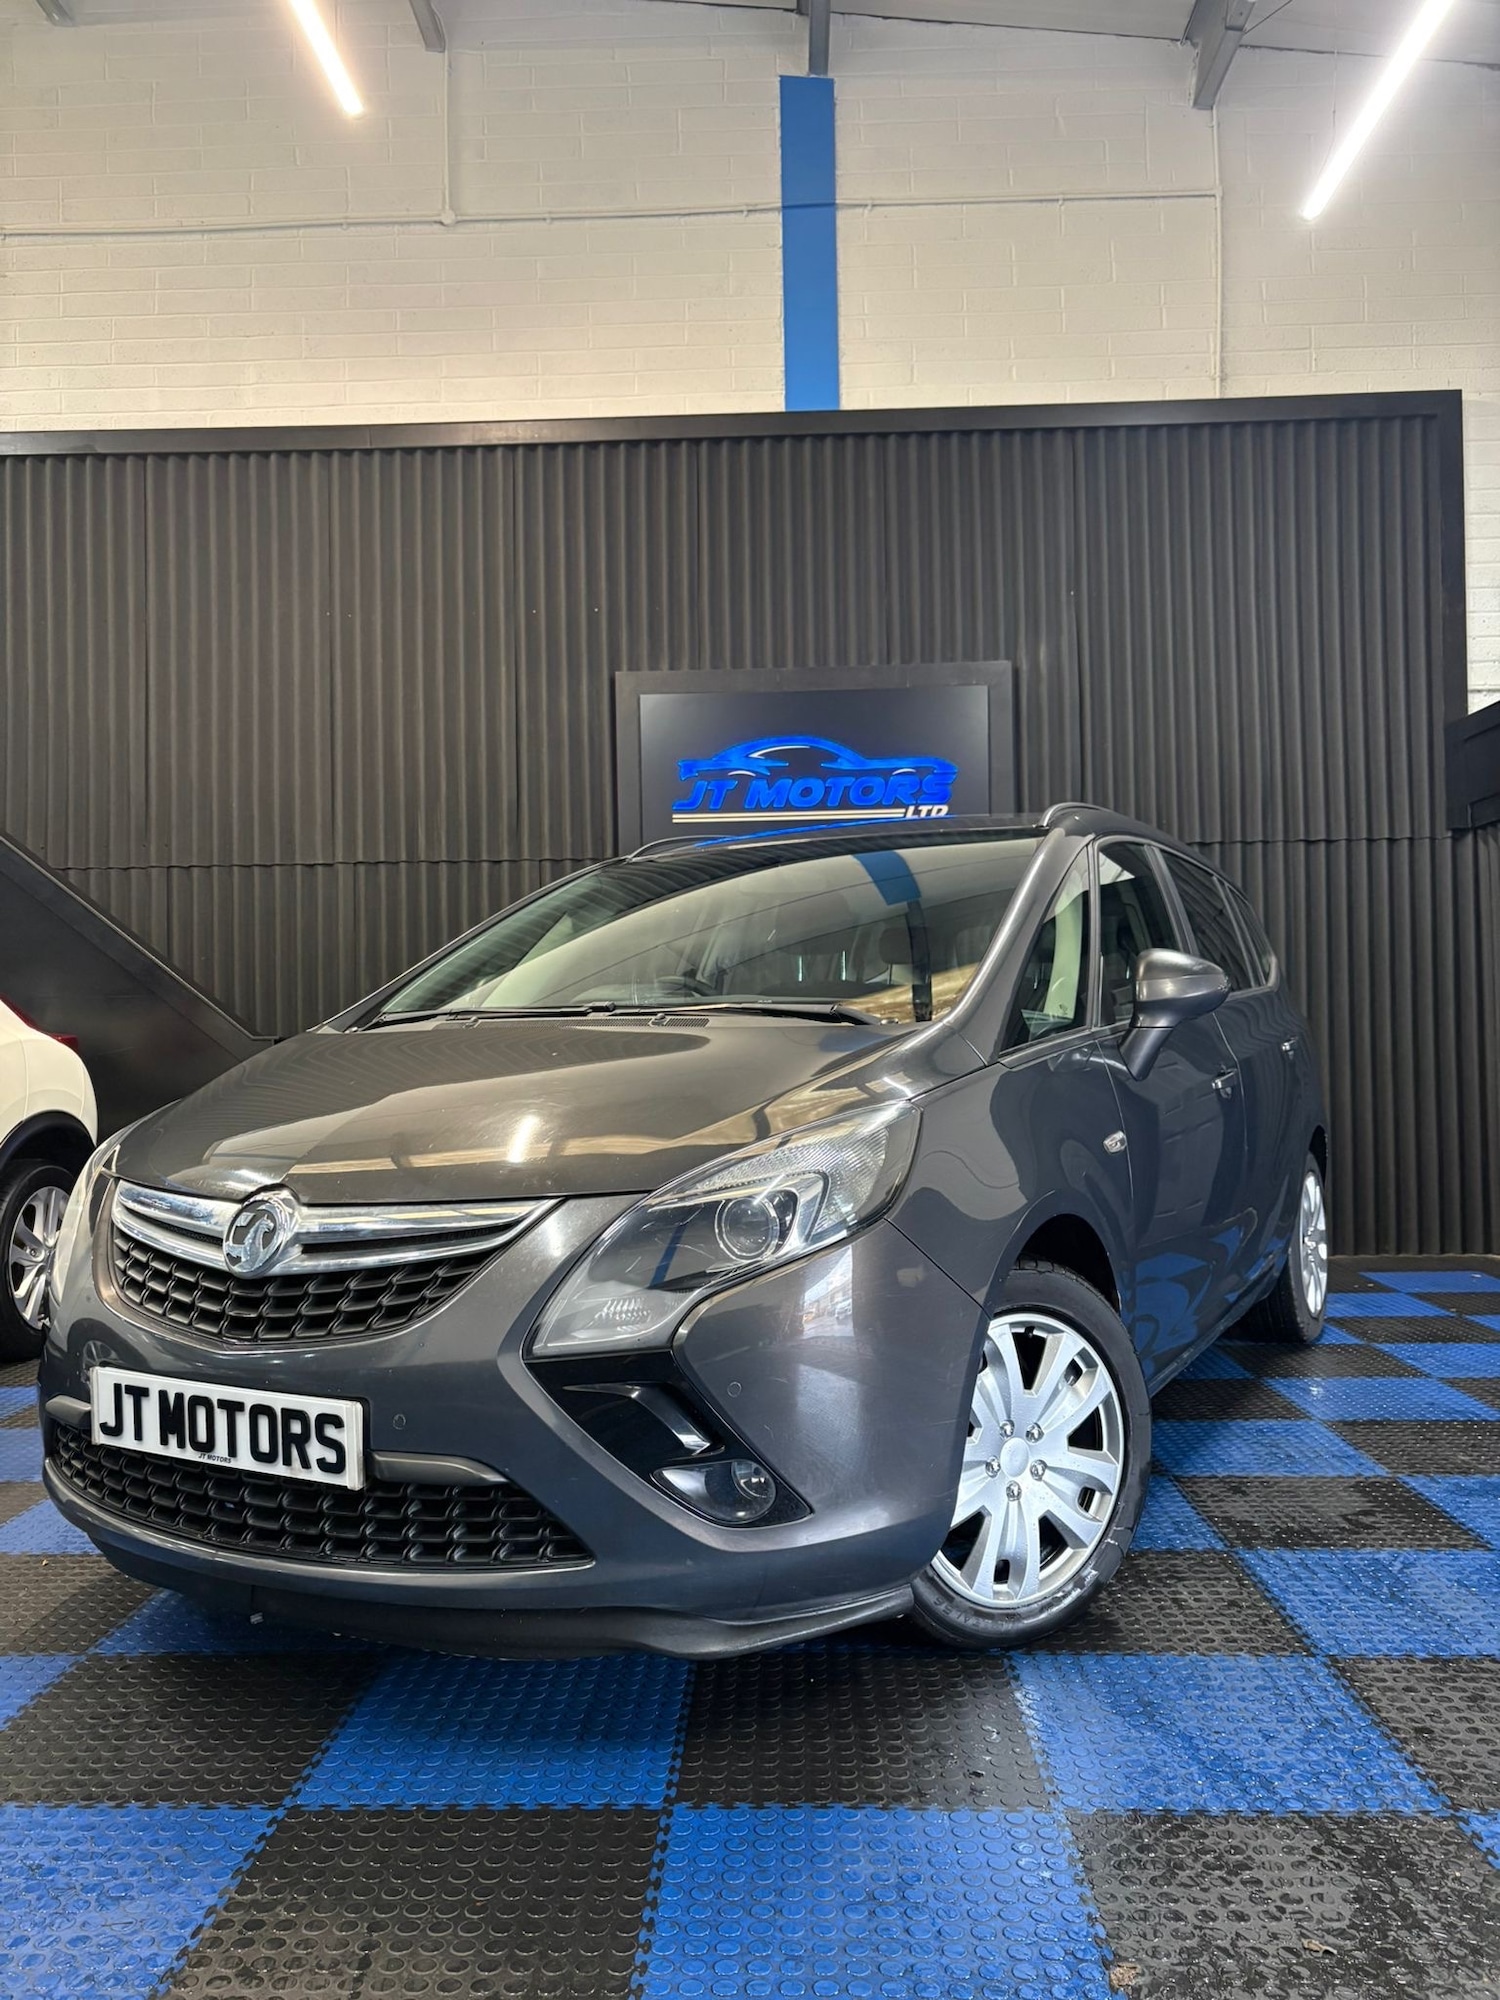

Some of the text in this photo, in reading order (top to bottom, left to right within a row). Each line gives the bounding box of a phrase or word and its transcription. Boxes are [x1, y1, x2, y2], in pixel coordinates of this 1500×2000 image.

[672, 773, 957, 810] JT MOTORS
[905, 804, 949, 819] LTD
[100, 1383, 347, 1474] JT MOTORS
[207, 1454, 232, 1463] MOTORS
